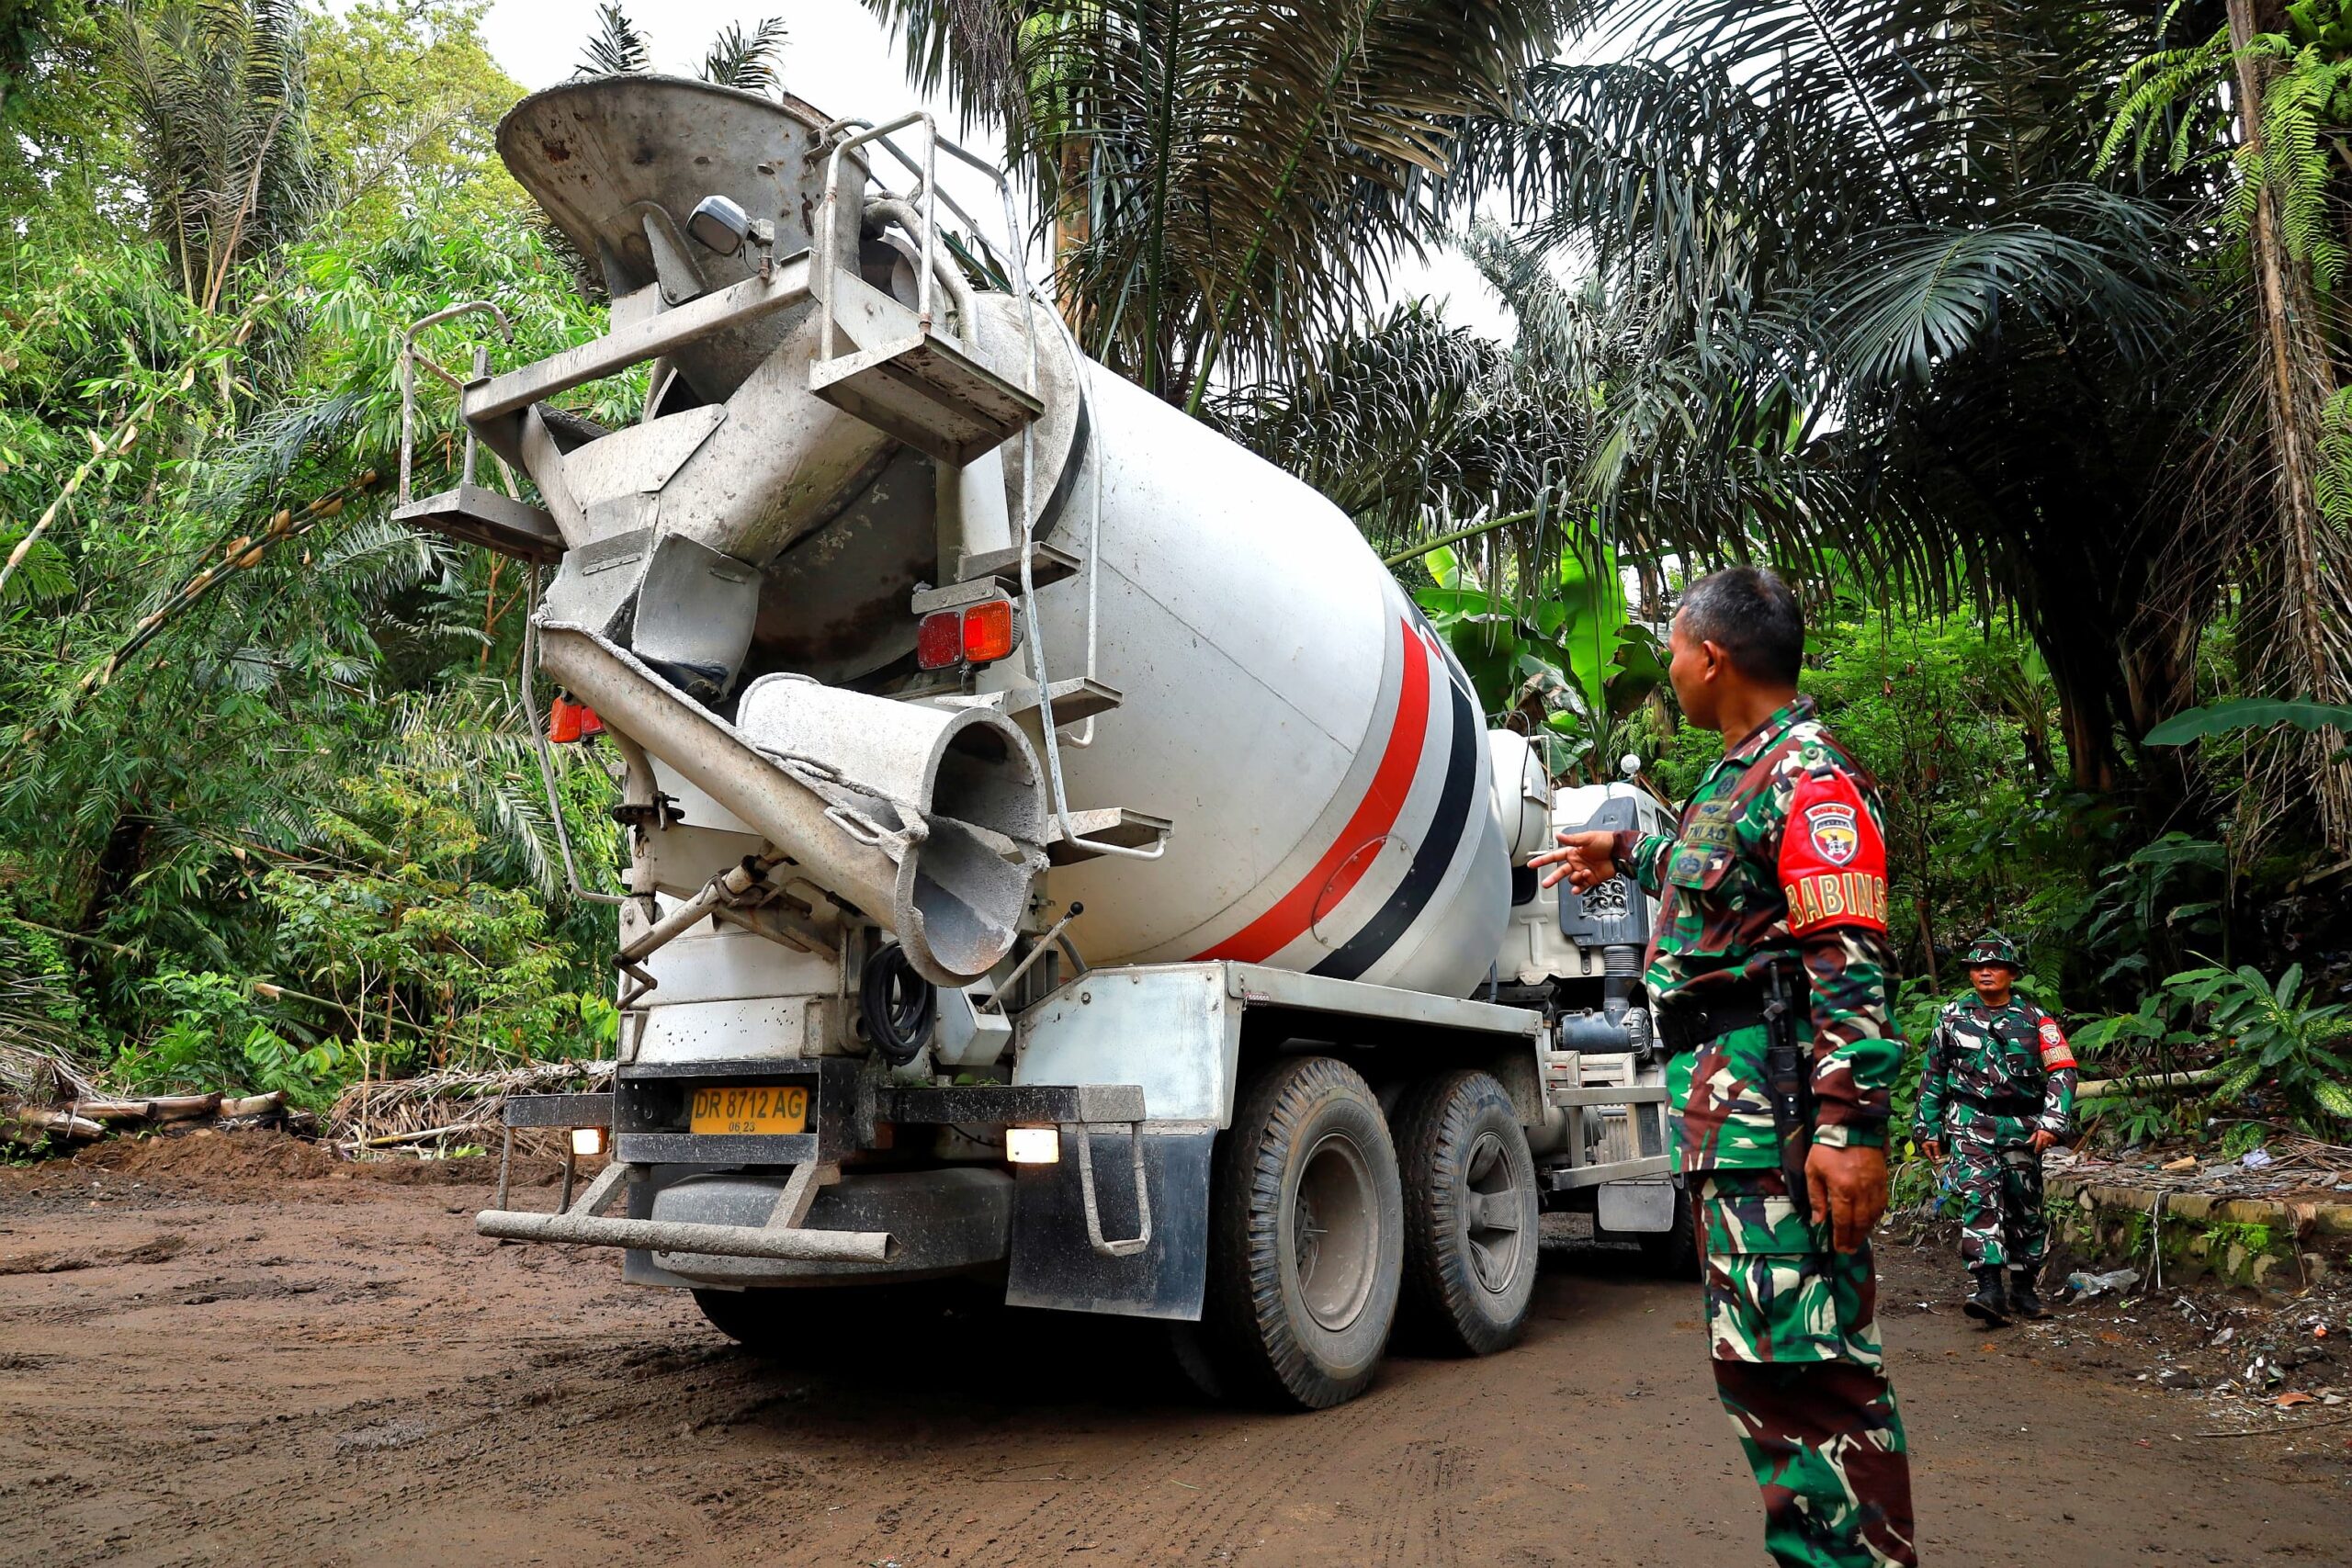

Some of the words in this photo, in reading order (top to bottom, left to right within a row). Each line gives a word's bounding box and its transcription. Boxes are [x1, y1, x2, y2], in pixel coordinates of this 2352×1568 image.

[1706, 825, 1728, 840] AD
[1785, 872, 1888, 930] BABINS
[695, 1089, 722, 1119] DR
[726, 1089, 769, 1119] 8712
[772, 1089, 803, 1119] AG
